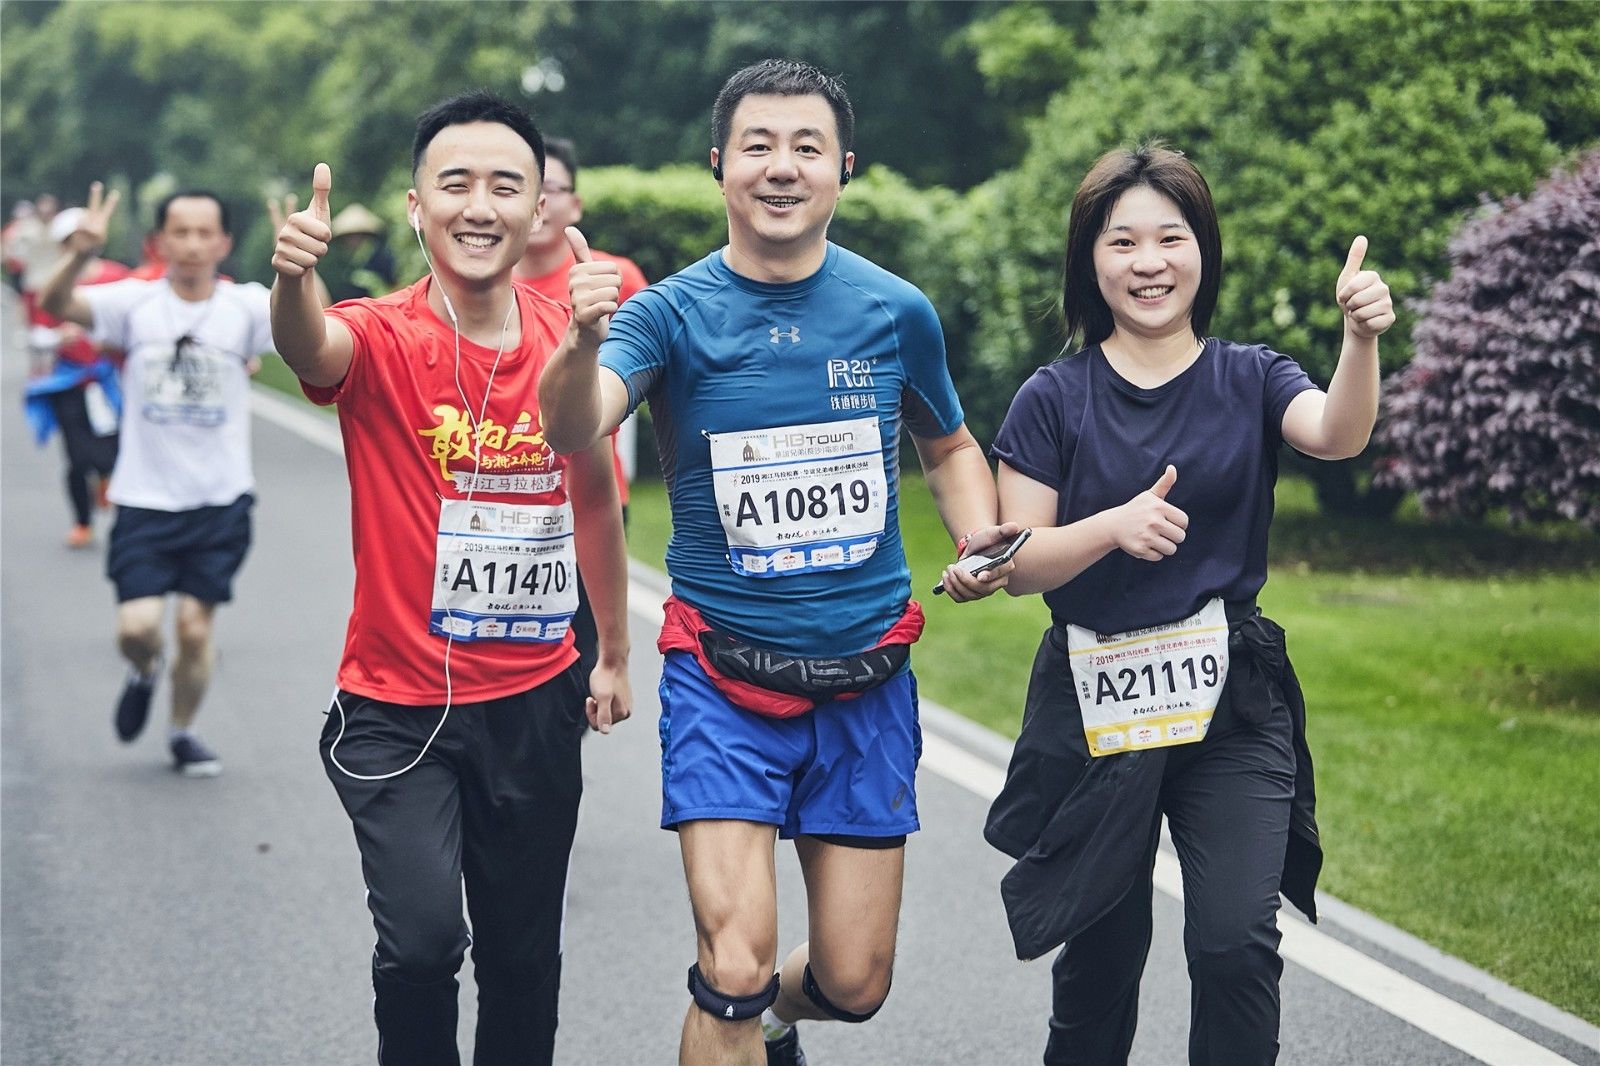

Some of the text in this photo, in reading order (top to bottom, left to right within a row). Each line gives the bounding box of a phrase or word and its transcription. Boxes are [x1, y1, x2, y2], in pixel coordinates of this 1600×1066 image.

[463, 475, 557, 491] 湘江马拉松赛
[740, 473, 761, 485] 2019
[736, 479, 870, 528] A10819
[464, 543, 483, 552] 2019
[451, 558, 567, 595] A11470
[1096, 655, 1114, 666] 2019
[1096, 654, 1218, 706] A21119
